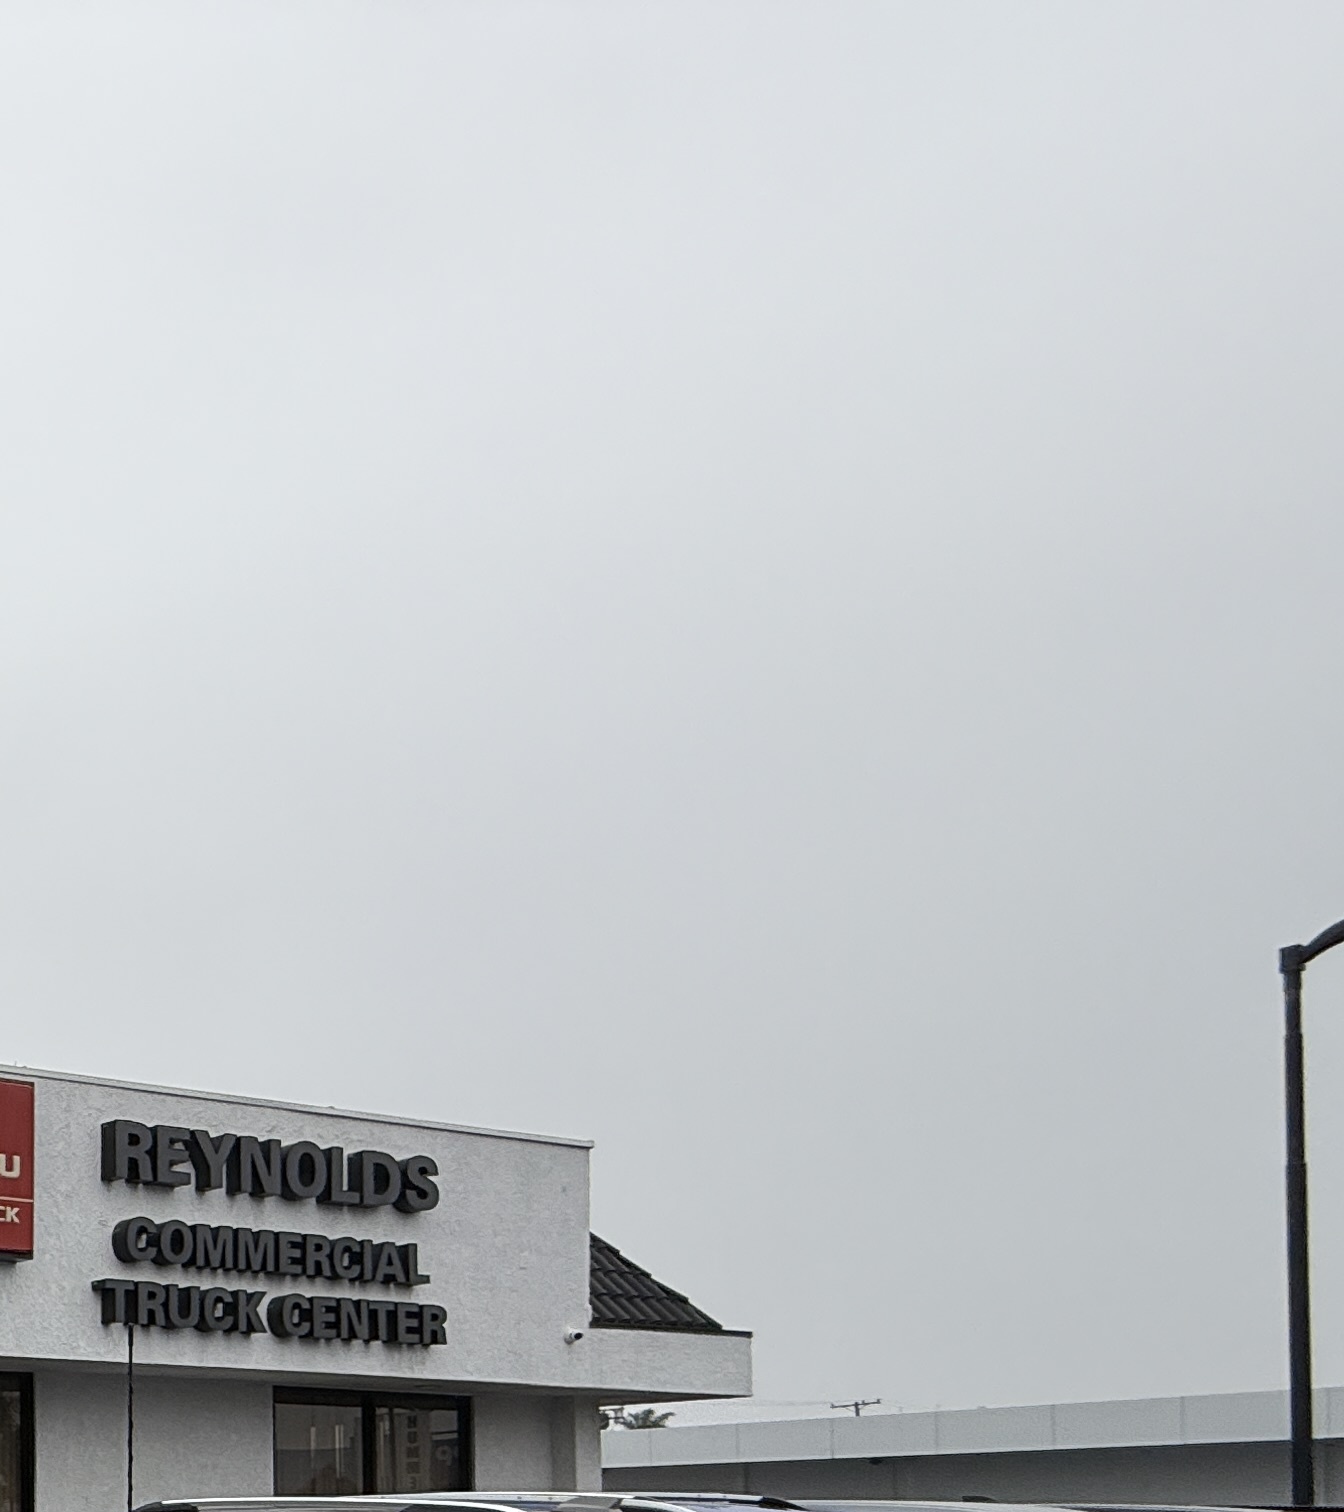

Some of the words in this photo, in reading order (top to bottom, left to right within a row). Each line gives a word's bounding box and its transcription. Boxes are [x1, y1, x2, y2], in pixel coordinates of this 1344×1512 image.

[101, 1119, 440, 1213] REYNOLDS
[112, 1216, 431, 1285] COMMERCIAL
[91, 1278, 267, 1334] TRUCK
[266, 1293, 448, 1346] CENTER
